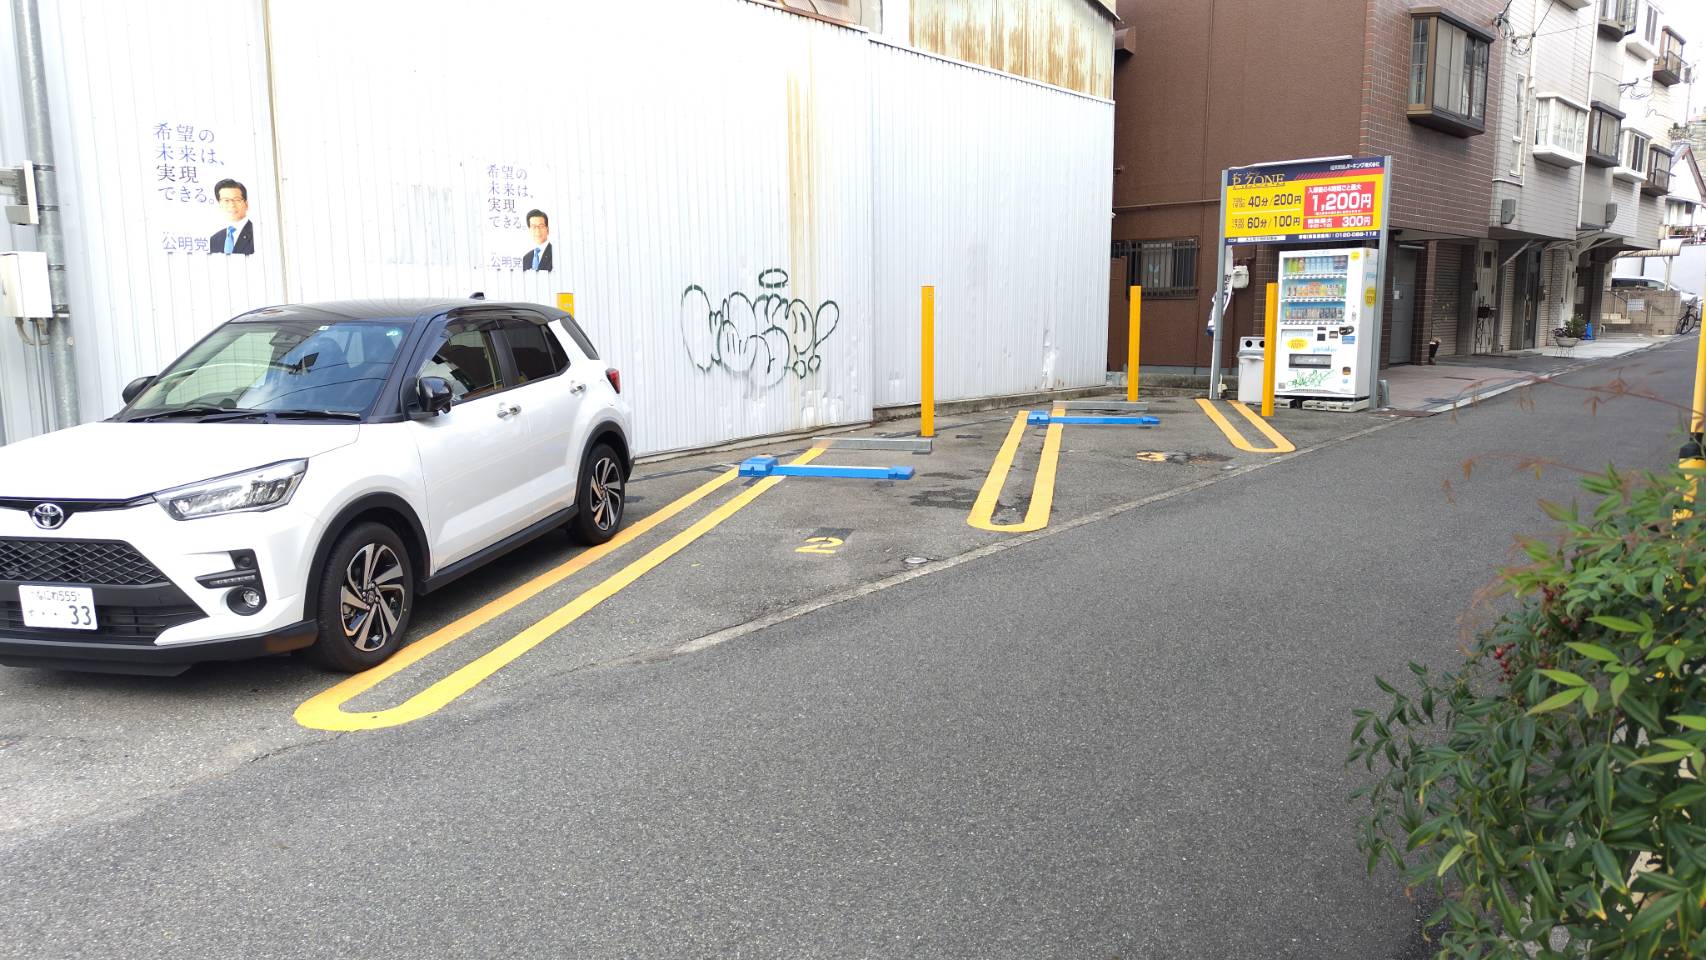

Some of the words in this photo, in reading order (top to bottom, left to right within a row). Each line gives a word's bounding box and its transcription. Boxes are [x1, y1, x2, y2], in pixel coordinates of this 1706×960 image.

[153, 122, 215, 143] 希望の
[155, 142, 225, 165] 未来は、
[156, 163, 199, 183] 実現
[487, 163, 528, 180] 希望の
[1245, 172, 1286, 188] ZONE
[158, 185, 215, 205] できる。
[488, 180, 534, 198] 未来は、
[487, 197, 517, 213] 実現
[1312, 191, 1373, 212] 1,200円
[488, 214, 527, 231] できる。
[1341, 215, 1371, 228] 300円
[162, 235, 210, 252] 公明党
[490, 254, 523, 268] 公明党
[795, 536, 844, 554] 2
[68, 604, 92, 626] 33
